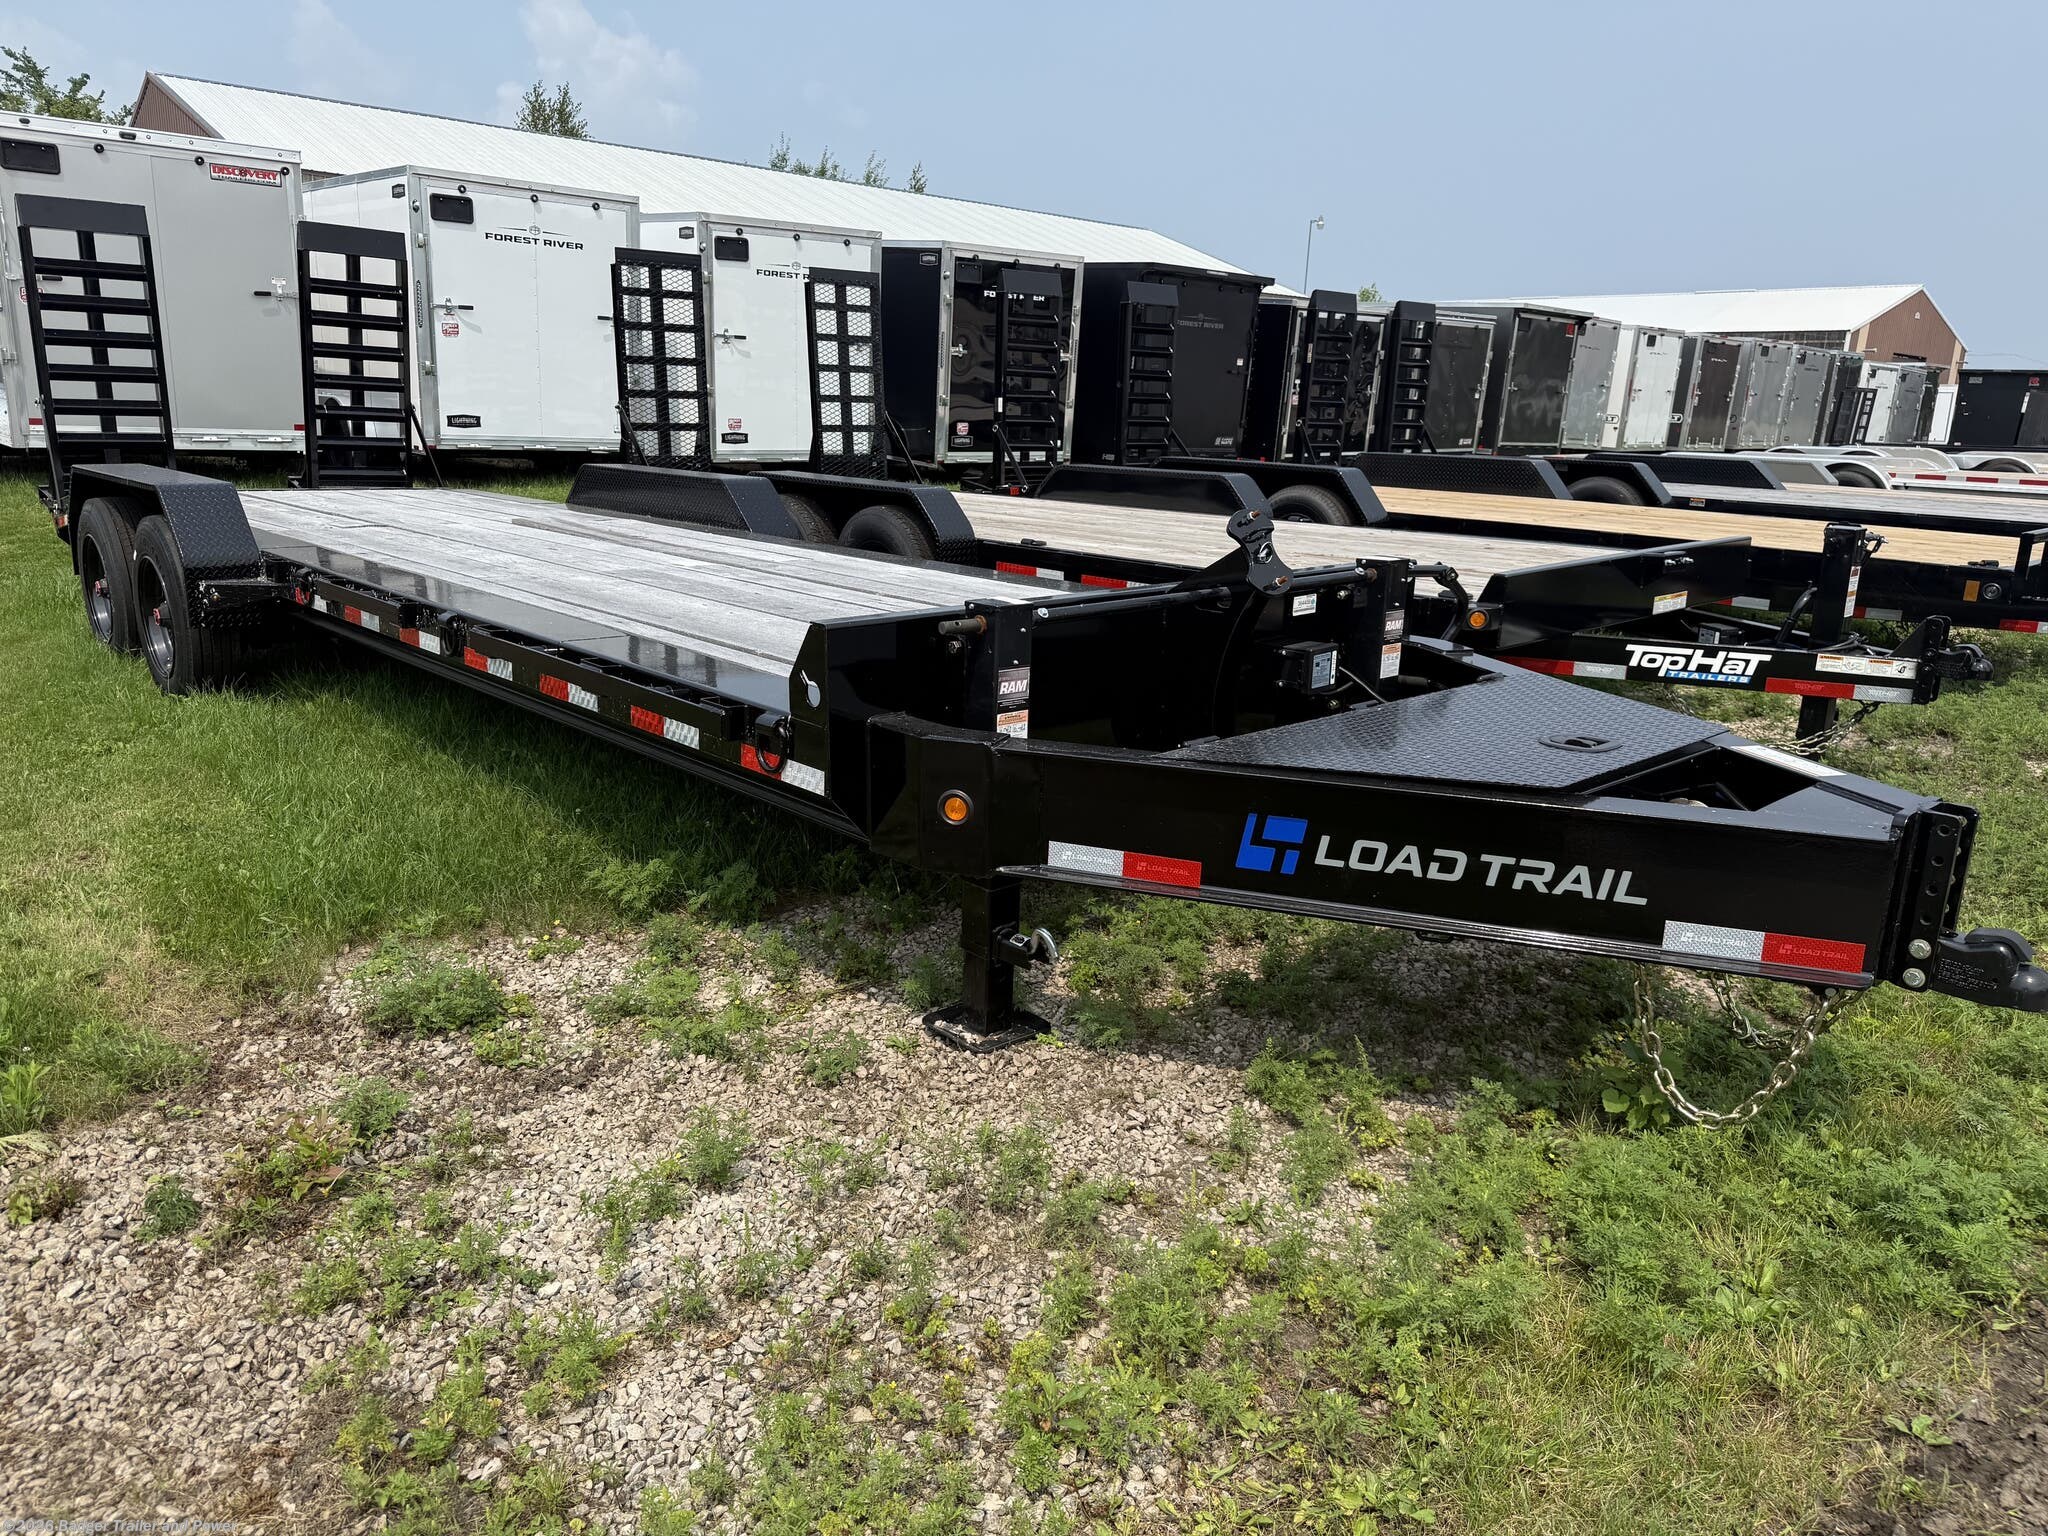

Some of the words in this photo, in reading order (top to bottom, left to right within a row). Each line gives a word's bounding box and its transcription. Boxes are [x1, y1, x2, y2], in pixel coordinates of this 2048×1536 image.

[211, 164, 278, 181] DISCOVERY
[485, 232, 540, 245] FOREST
[543, 239, 584, 250] RIVER
[756, 268, 800, 279] FOREST
[1384, 620, 1402, 631] RAM
[1667, 670, 1750, 684] TRAILERS
[1000, 679, 1028, 695] RAM
[1147, 865, 1168, 873] LOAD
[1169, 867, 1190, 876] TRAIL
[1314, 835, 1467, 882] LOAD
[1479, 853, 1648, 906] TRAIL
[1793, 948, 1821, 957] LOAD
[1822, 950, 1849, 960] TRAIL
